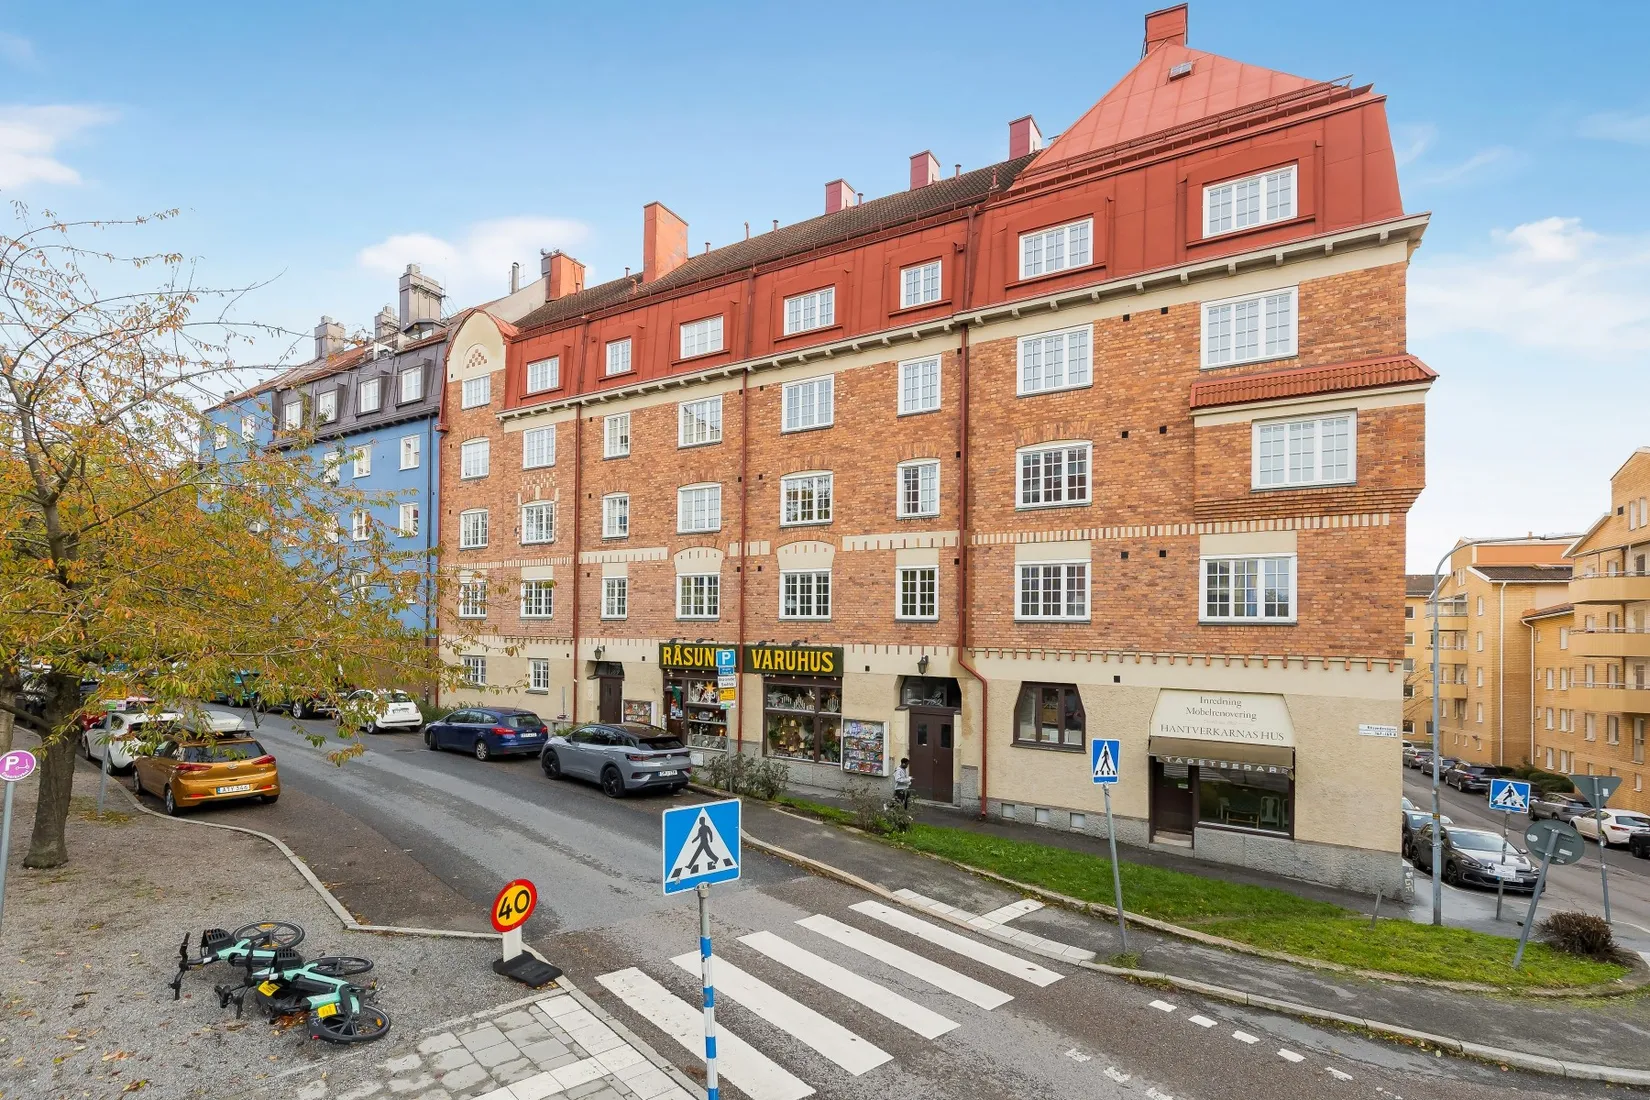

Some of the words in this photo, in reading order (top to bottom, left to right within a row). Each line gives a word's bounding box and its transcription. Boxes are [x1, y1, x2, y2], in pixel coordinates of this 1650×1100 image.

[663, 644, 737, 668] RÅSUN
[751, 649, 834, 673] VARUHUS
[721, 651, 731, 665] P
[1200, 696, 1242, 709] Inredning
[1160, 724, 1258, 739] HANTVERKARNAS
[1260, 731, 1285, 741] HUS
[5, 755, 20, 772] P
[498, 889, 531, 921] 40
